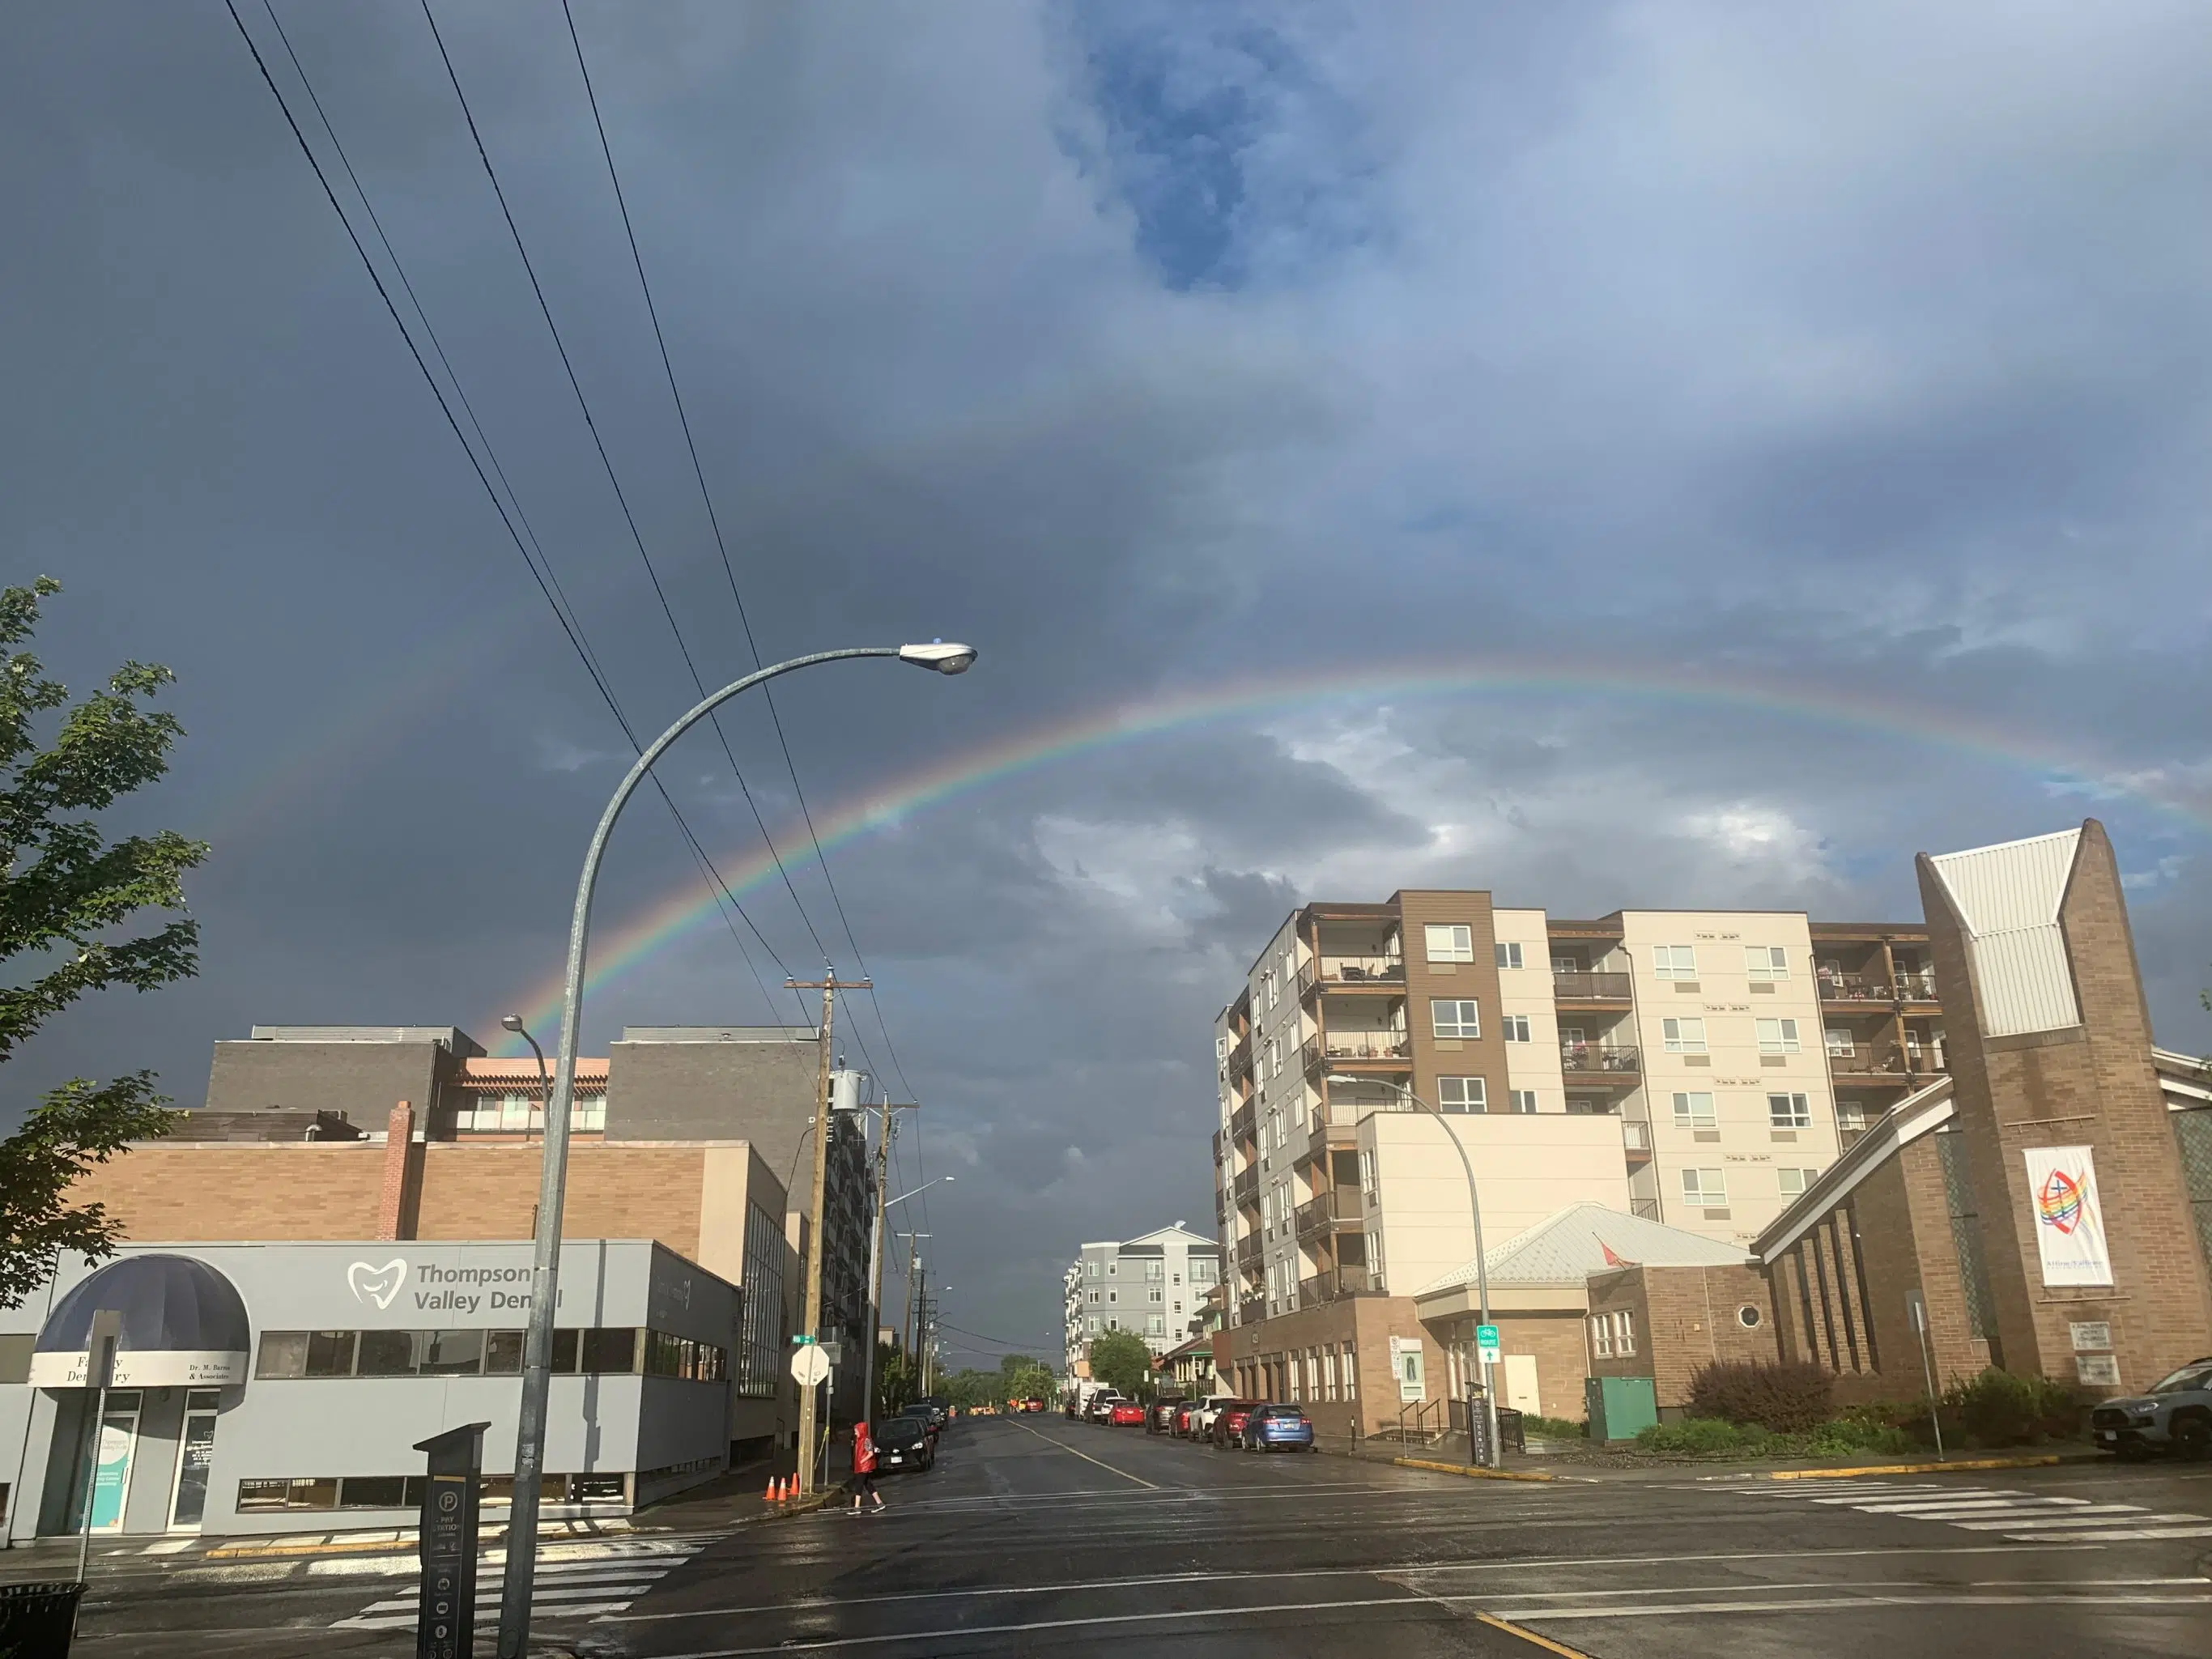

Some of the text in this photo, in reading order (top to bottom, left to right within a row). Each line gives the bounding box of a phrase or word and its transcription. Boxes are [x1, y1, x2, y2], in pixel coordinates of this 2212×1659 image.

[417, 1264, 531, 1287] Thompson
[415, 1289, 564, 1314] Valley Denl
[440, 1516, 455, 1524] PAY
